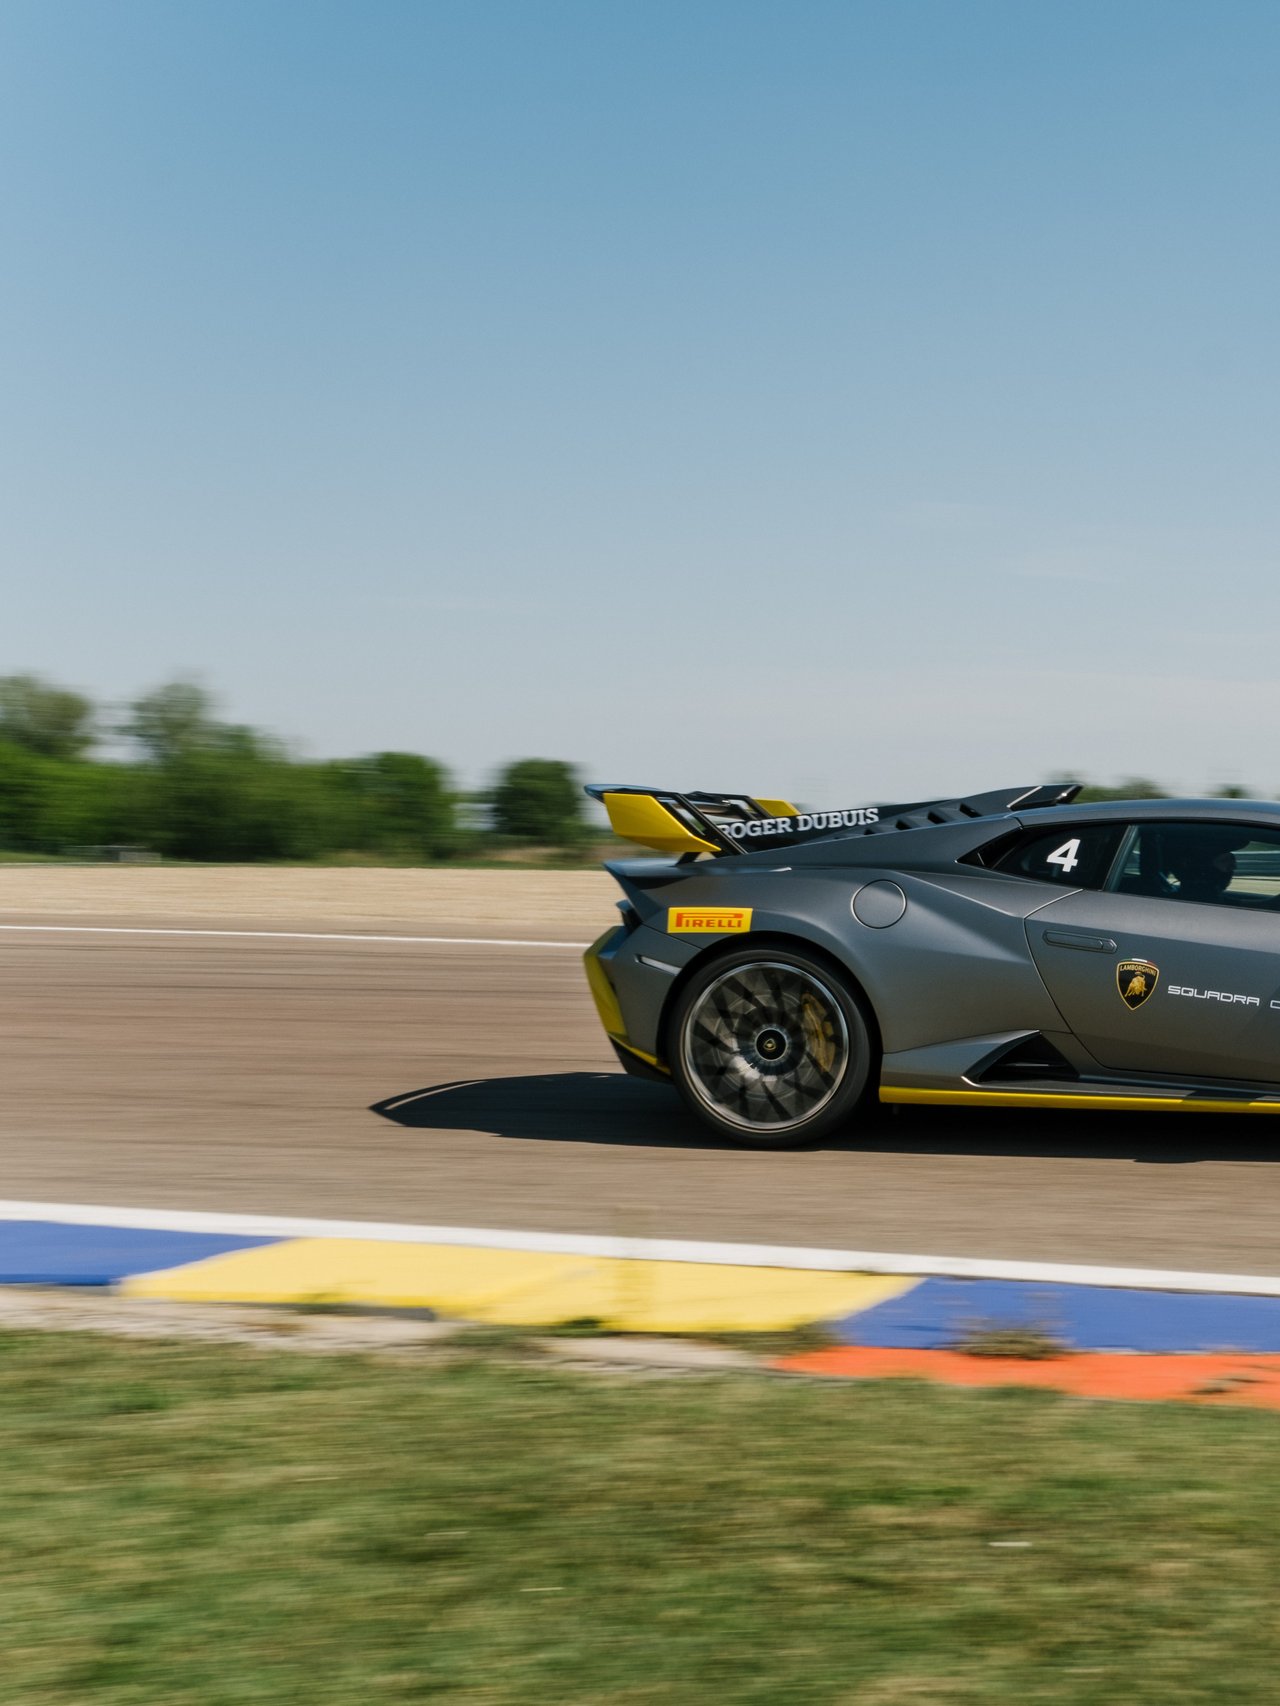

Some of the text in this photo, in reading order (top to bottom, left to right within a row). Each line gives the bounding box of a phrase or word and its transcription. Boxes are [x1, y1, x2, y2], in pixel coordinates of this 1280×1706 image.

[797, 808, 880, 831] DUBUIS
[1046, 838, 1081, 873] 4
[675, 912, 744, 928] PIRELLI
[1119, 964, 1157, 976] LAMBORGHINI
[1167, 985, 1260, 1007] SQUADRA
